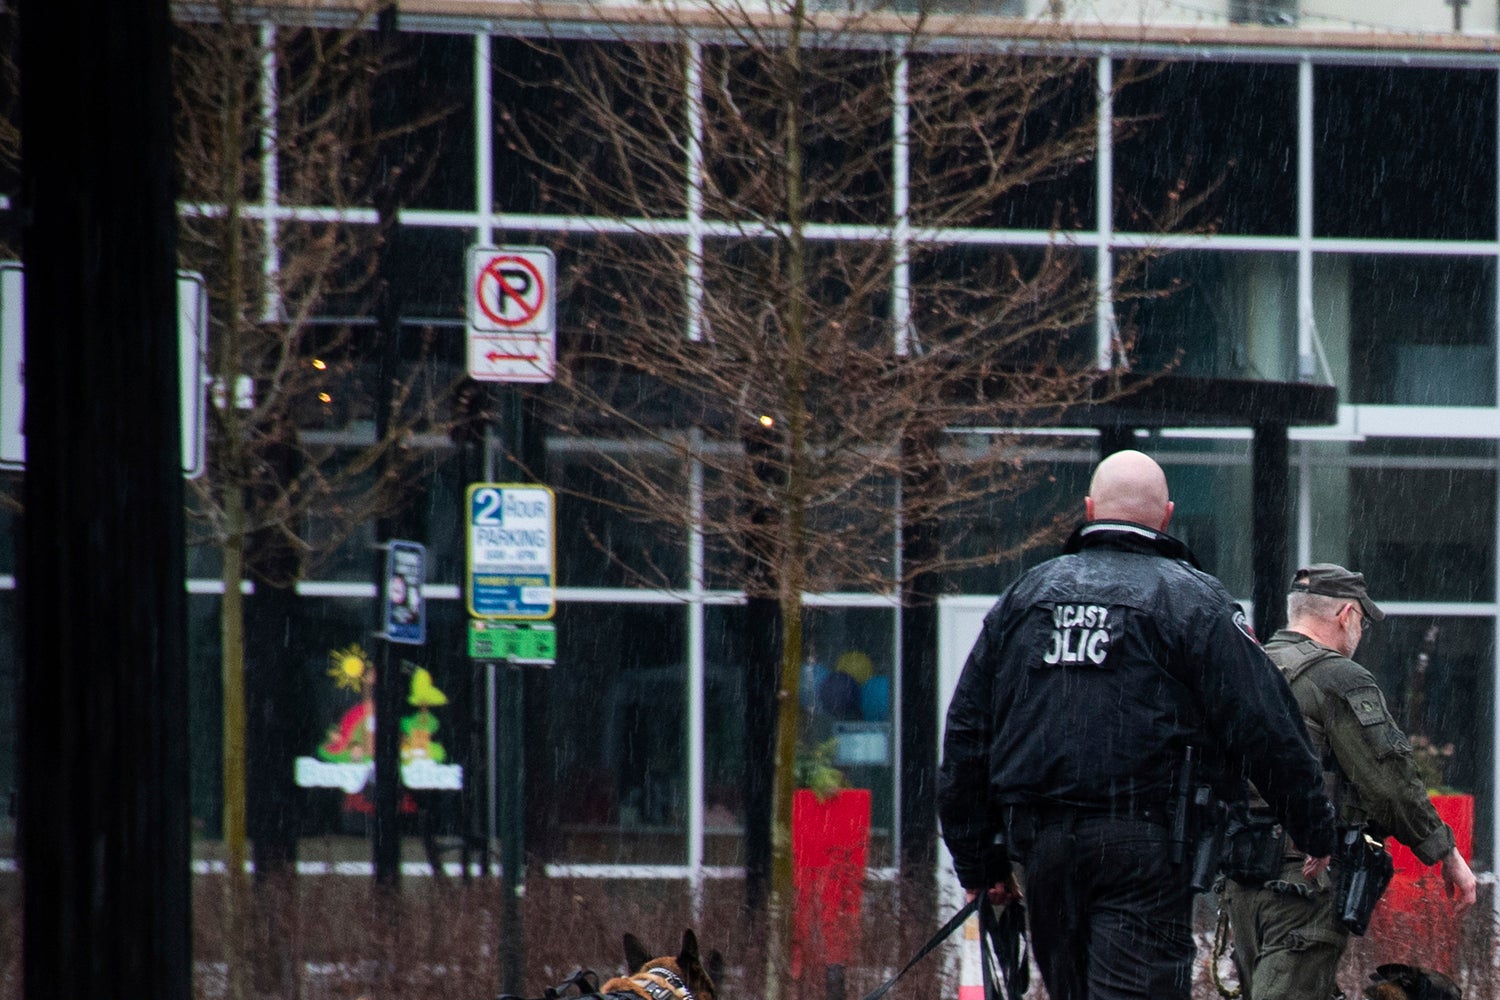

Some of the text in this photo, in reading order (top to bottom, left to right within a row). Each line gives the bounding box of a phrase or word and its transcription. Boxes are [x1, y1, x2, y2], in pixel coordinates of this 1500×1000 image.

[473, 488, 546, 526] 2 HOUR
[476, 529, 546, 548] PARKING
